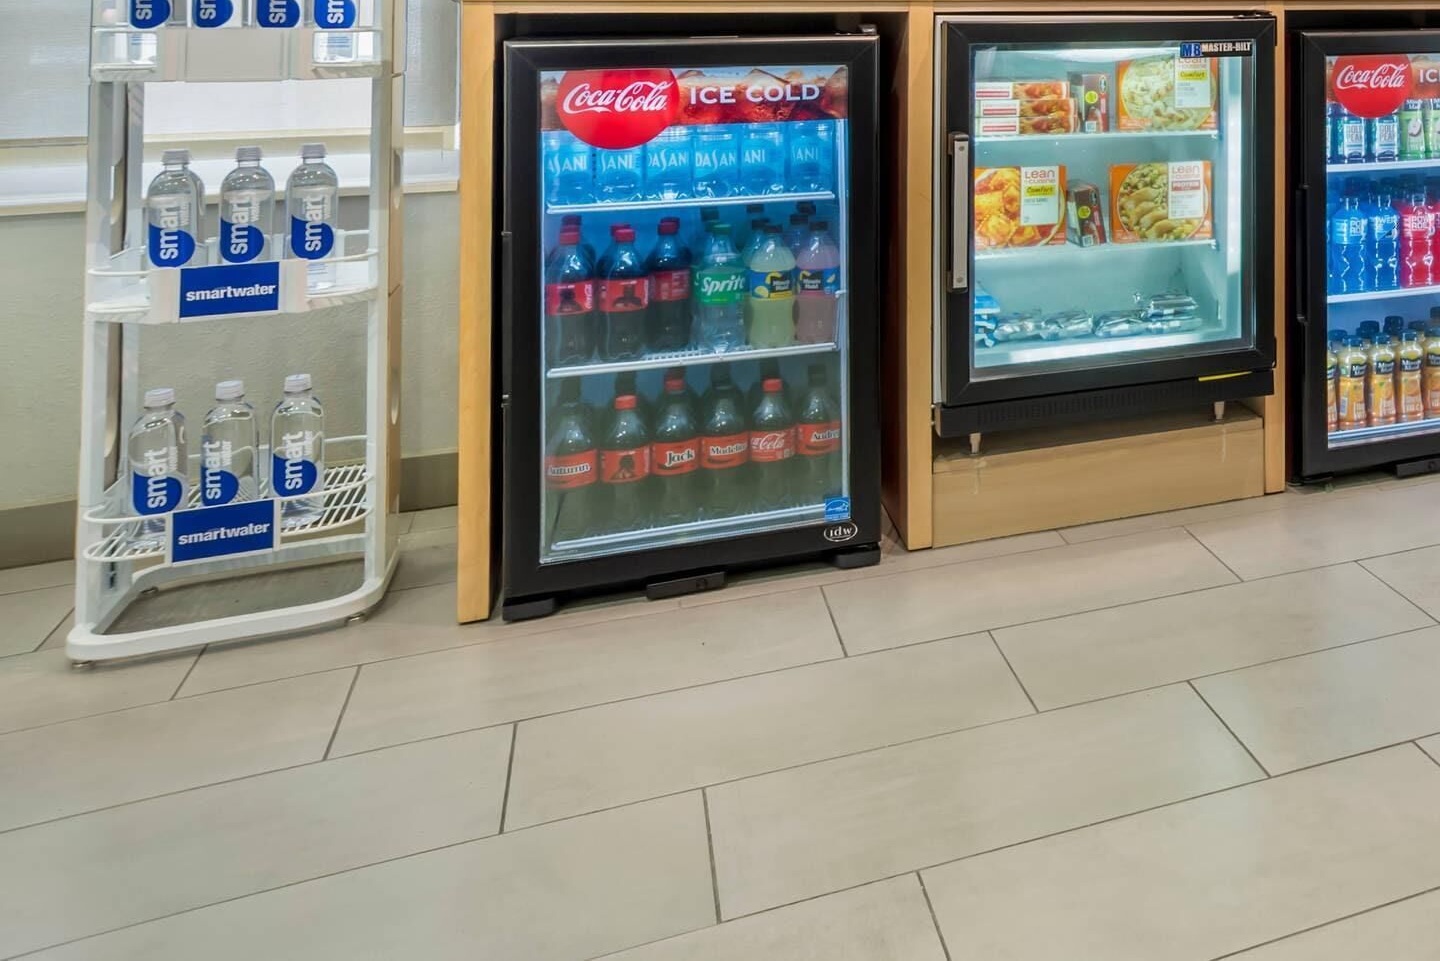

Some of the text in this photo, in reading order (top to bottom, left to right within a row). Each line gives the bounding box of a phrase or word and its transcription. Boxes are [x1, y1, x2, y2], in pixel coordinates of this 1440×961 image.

[1201, 41, 1252, 52] MASTER-BILT
[1336, 63, 1408, 90] Coca-Cola
[562, 81, 673, 115] Coca-Cola
[690, 84, 820, 105] ICE COLD
[695, 149, 737, 170] DASAN
[1025, 169, 1055, 179] Lean
[160, 199, 177, 260] smart
[230, 194, 248, 254] smart
[304, 193, 323, 252] smart
[185, 282, 277, 302] smartwater
[205, 439, 221, 501] smart
[285, 431, 303, 491] smart
[665, 448, 695, 468] Jack
[146, 446, 167, 508] smart
[178, 521, 270, 547] smartwater
